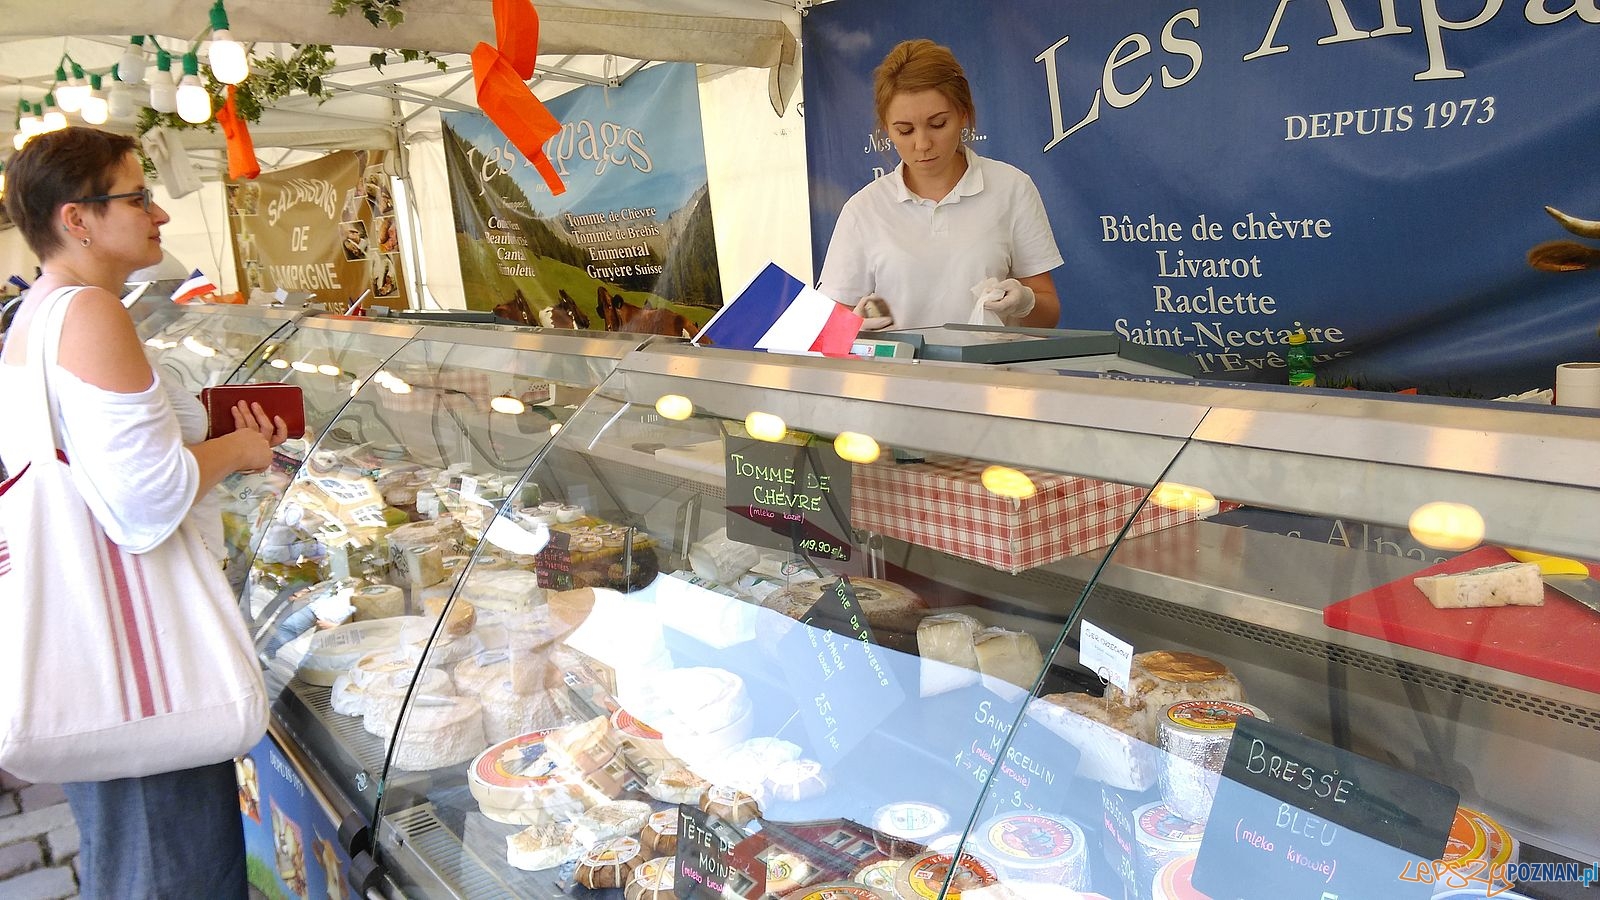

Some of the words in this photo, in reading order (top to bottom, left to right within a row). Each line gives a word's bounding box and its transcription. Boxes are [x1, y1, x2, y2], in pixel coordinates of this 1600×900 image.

[1034, 8, 1203, 153] Les
[1284, 103, 1414, 142] DEPUIS
[1423, 95, 1497, 130] 1973
[267, 178, 338, 227] SALAISONS
[565, 212, 606, 228] Tomme
[609, 211, 619, 222] de
[621, 207, 656, 220] Chèvre
[291, 225, 311, 252] DE
[572, 229, 612, 244] Tomme
[615, 231, 626, 240] de
[628, 225, 660, 239] Brebis
[1099, 214, 1182, 243] Bûche
[1191, 214, 1223, 241] de
[1231, 212, 1332, 241] chèvre
[588, 241, 650, 261] Emmental
[1155, 249, 1263, 279] Livarot
[586, 263, 633, 282] Gruyère
[634, 263, 662, 276] Suisse
[1152, 285, 1277, 315] Raclette
[1114, 317, 1346, 348] Saint-Nectaire
[731, 453, 796, 485] TOMME
[807, 472, 831, 493] DE
[823, 628, 846, 671] BANON
[974, 700, 1013, 735] SAINT
[989, 734, 1055, 785] MRCELLIN
[1245, 738, 1354, 804] BRESSE
[1275, 802, 1337, 847] BLEU
[719, 836, 736, 857] DE
[699, 851, 737, 881] MOINE
